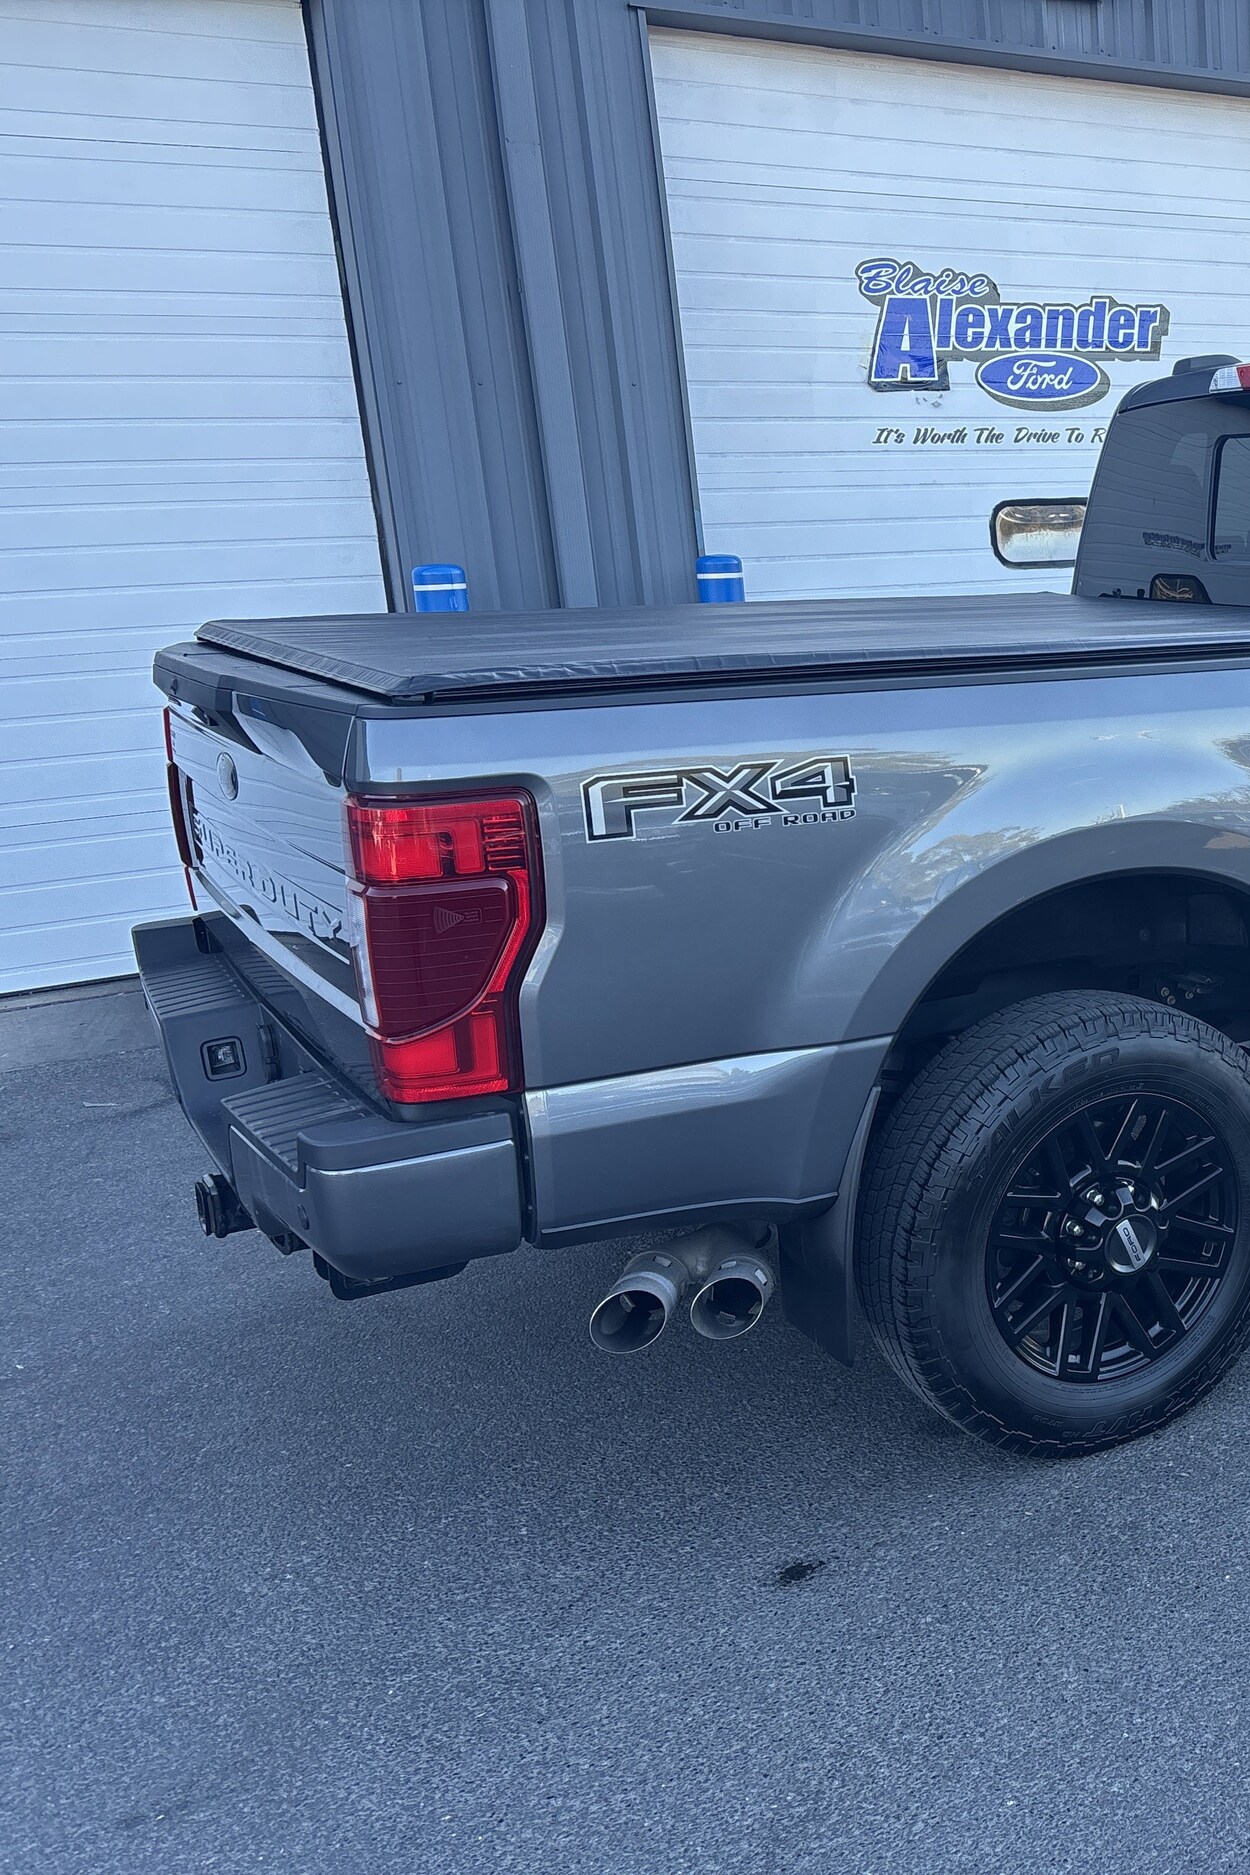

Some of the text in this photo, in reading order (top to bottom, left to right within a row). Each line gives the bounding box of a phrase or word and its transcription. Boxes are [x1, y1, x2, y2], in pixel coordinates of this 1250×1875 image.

[859, 262, 990, 298] Blaise
[872, 297, 1160, 382] Alexander
[1006, 359, 1073, 391] Ford
[872, 428, 905, 444] It's
[913, 428, 967, 446] Worth
[974, 428, 1005, 445] The
[1012, 427, 1060, 445] Drive
[1065, 427, 1085, 444] To
[580, 754, 857, 844] FX4
[712, 808, 856, 834] OFF ROAD
[1122, 1227, 1142, 1263] FORD
